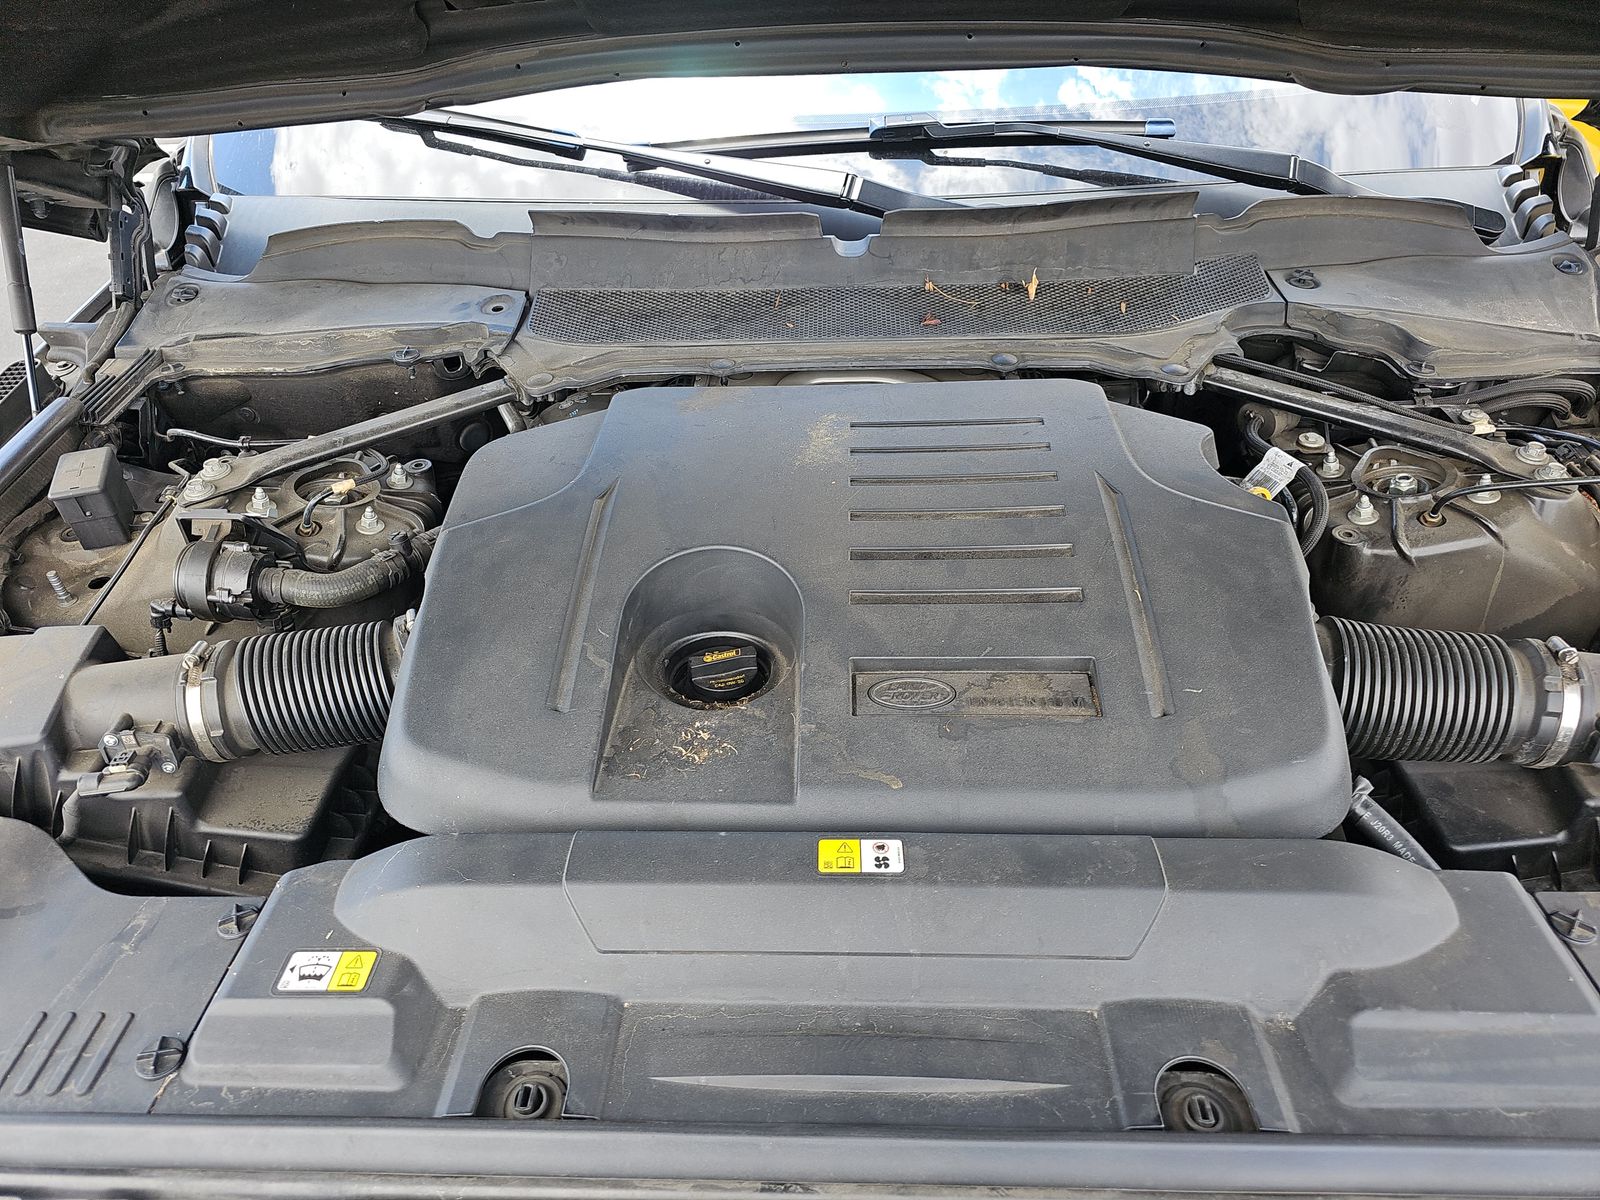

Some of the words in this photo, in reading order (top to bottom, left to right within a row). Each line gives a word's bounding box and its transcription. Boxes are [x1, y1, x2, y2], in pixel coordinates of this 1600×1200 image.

[712, 650, 736, 660] Castrol
[890, 691, 940, 701] ROVER
[1370, 819, 1395, 841] J20R3
